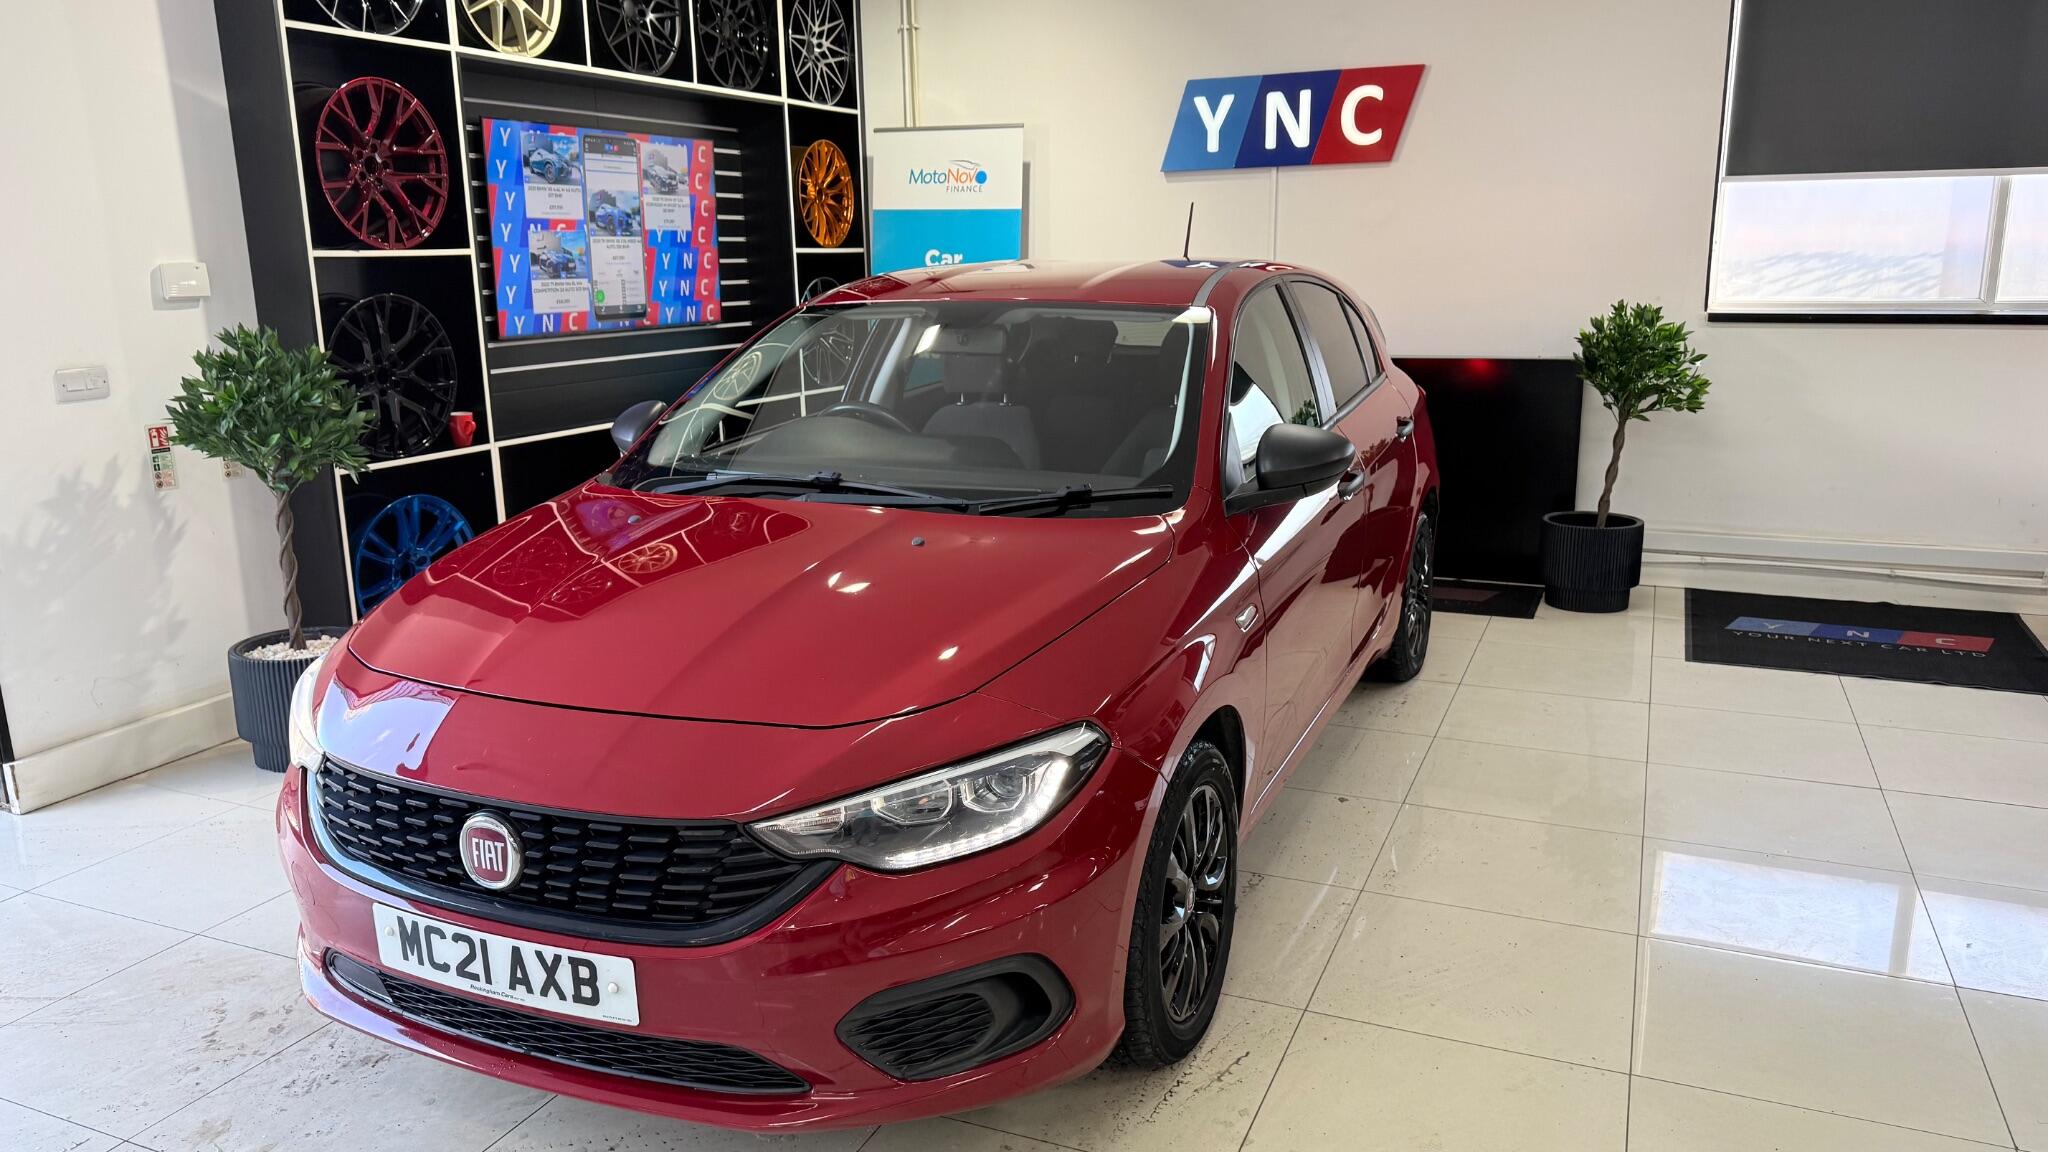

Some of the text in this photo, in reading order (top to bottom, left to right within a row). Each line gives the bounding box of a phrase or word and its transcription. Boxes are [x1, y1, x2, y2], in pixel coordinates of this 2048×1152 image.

[1193, 84, 1384, 153] YNC
[946, 185, 983, 193] FINANCE
[925, 249, 963, 267] Car
[1733, 630, 1986, 658] YOUR NEXT CAR LTD
[472, 837, 505, 872] FIAT
[396, 915, 601, 1007] MC21 AXB
